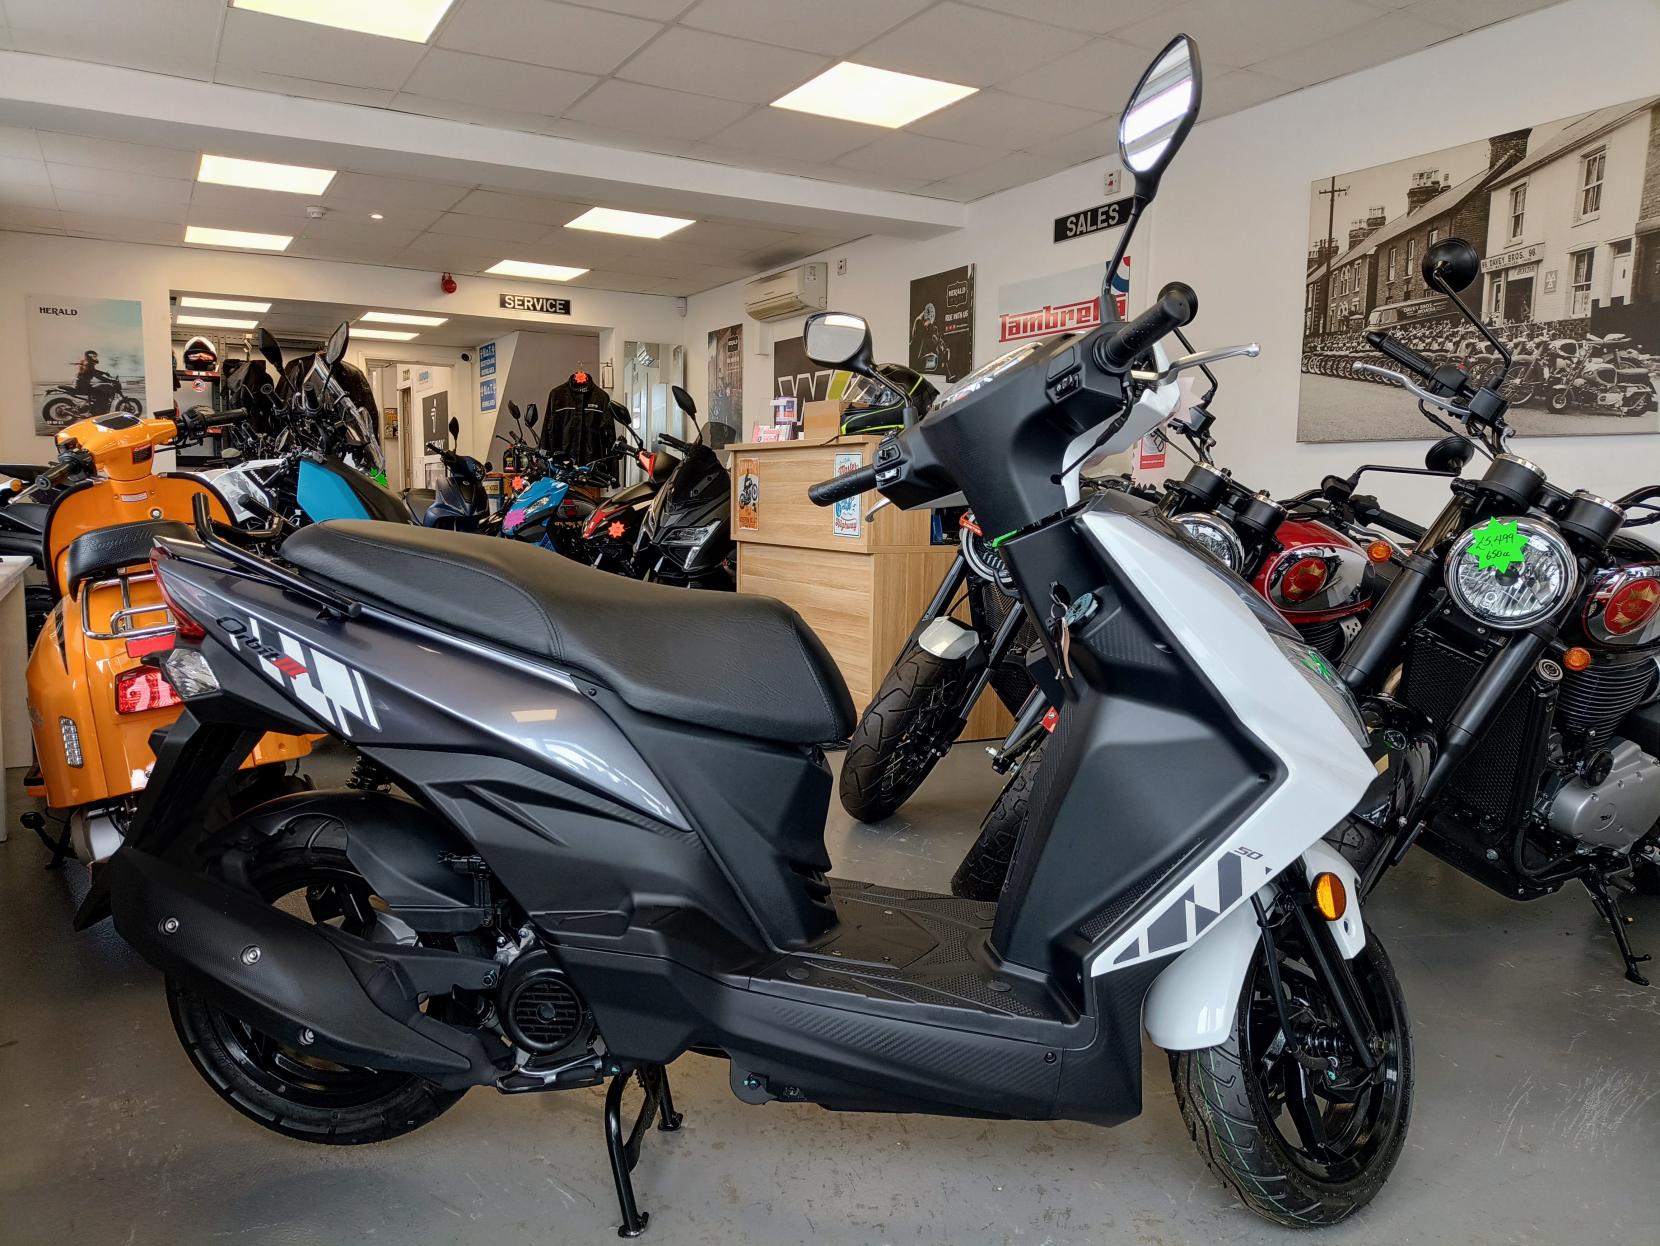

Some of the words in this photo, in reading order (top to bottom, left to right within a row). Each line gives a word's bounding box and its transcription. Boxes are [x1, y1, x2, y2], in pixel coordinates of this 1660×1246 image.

[1066, 204, 1120, 237] SALES
[1489, 257, 1506, 267] DAVEY
[948, 286, 966, 297] HERALD
[39, 306, 78, 316] HERALD
[504, 295, 566, 313] SERVICE
[1475, 533, 1514, 550] £5,499
[216, 616, 281, 661] Orbit
[1233, 846, 1264, 861] 50
